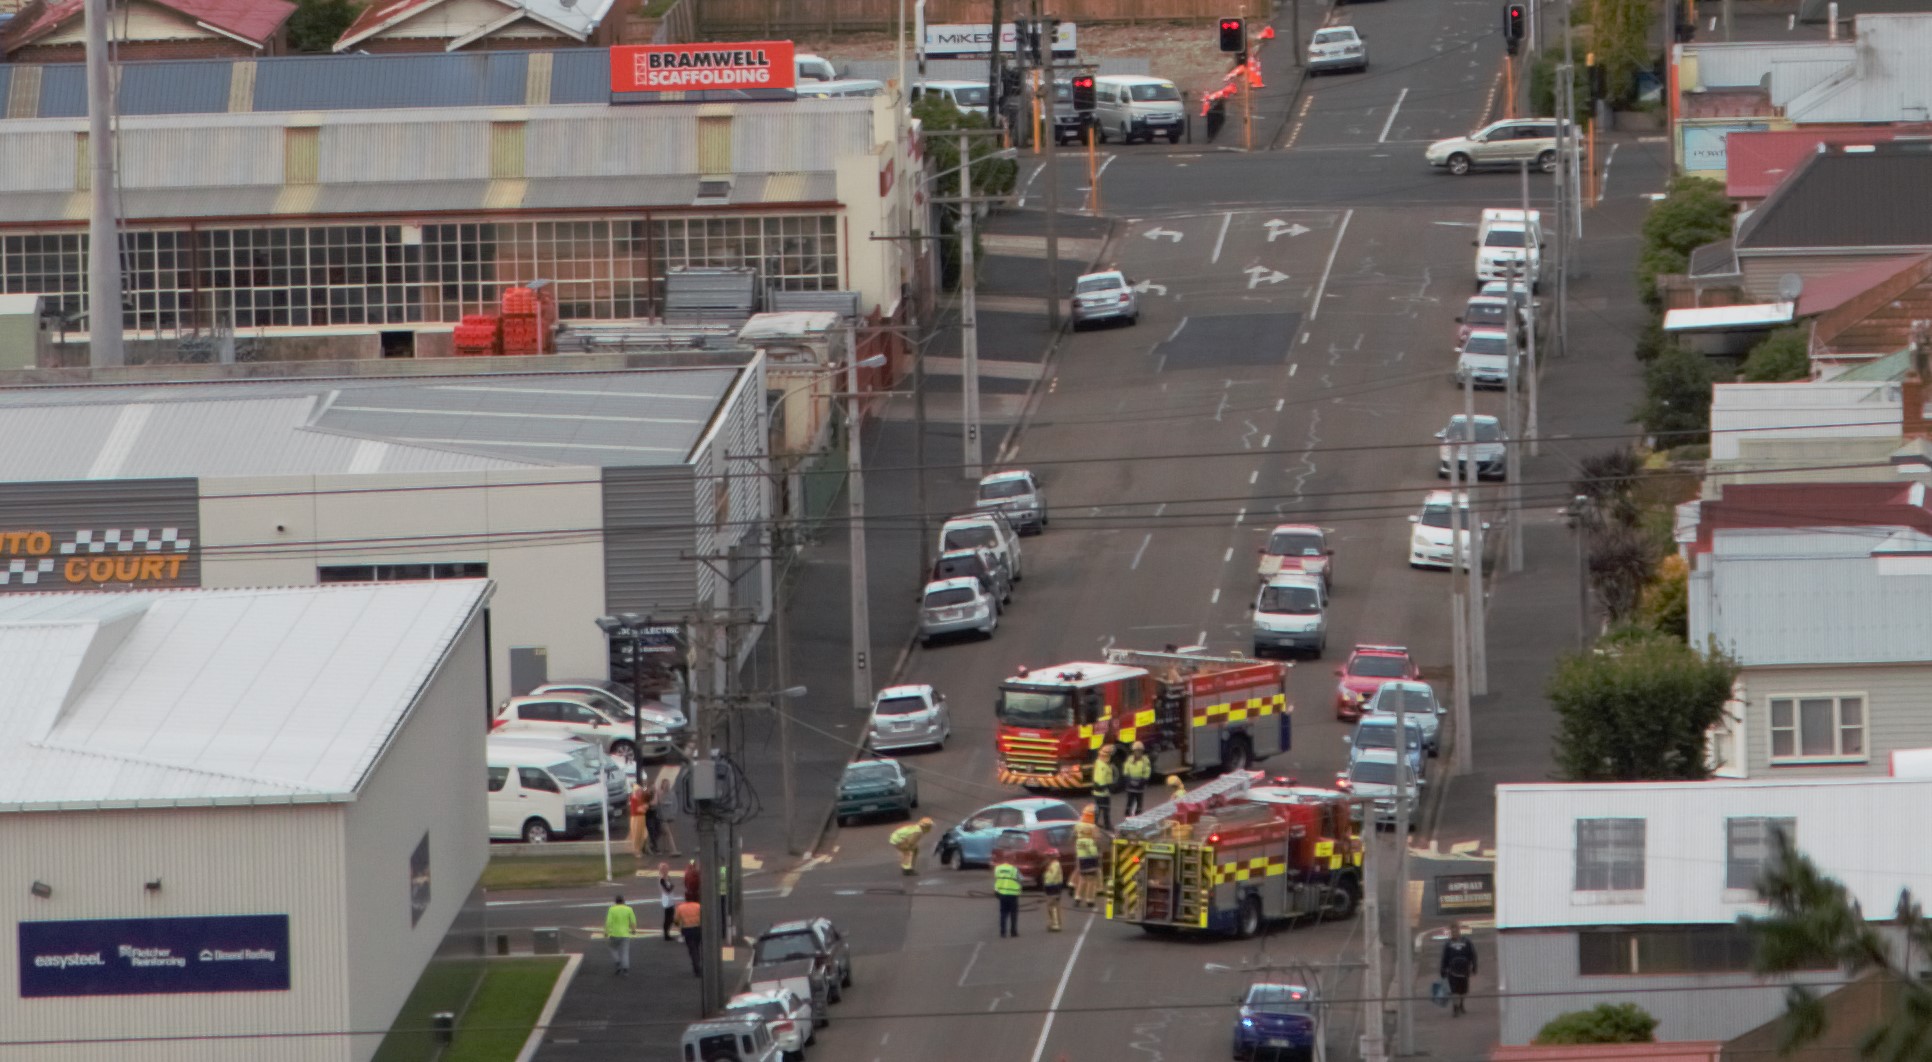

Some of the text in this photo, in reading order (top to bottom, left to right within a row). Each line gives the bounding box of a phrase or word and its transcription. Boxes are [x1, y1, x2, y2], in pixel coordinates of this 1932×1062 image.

[648, 50, 770, 69] BRAMWELL
[648, 69, 770, 86] SCAFFOLDING
[0, 531, 52, 555] TO
[64, 554, 189, 583] COURT
